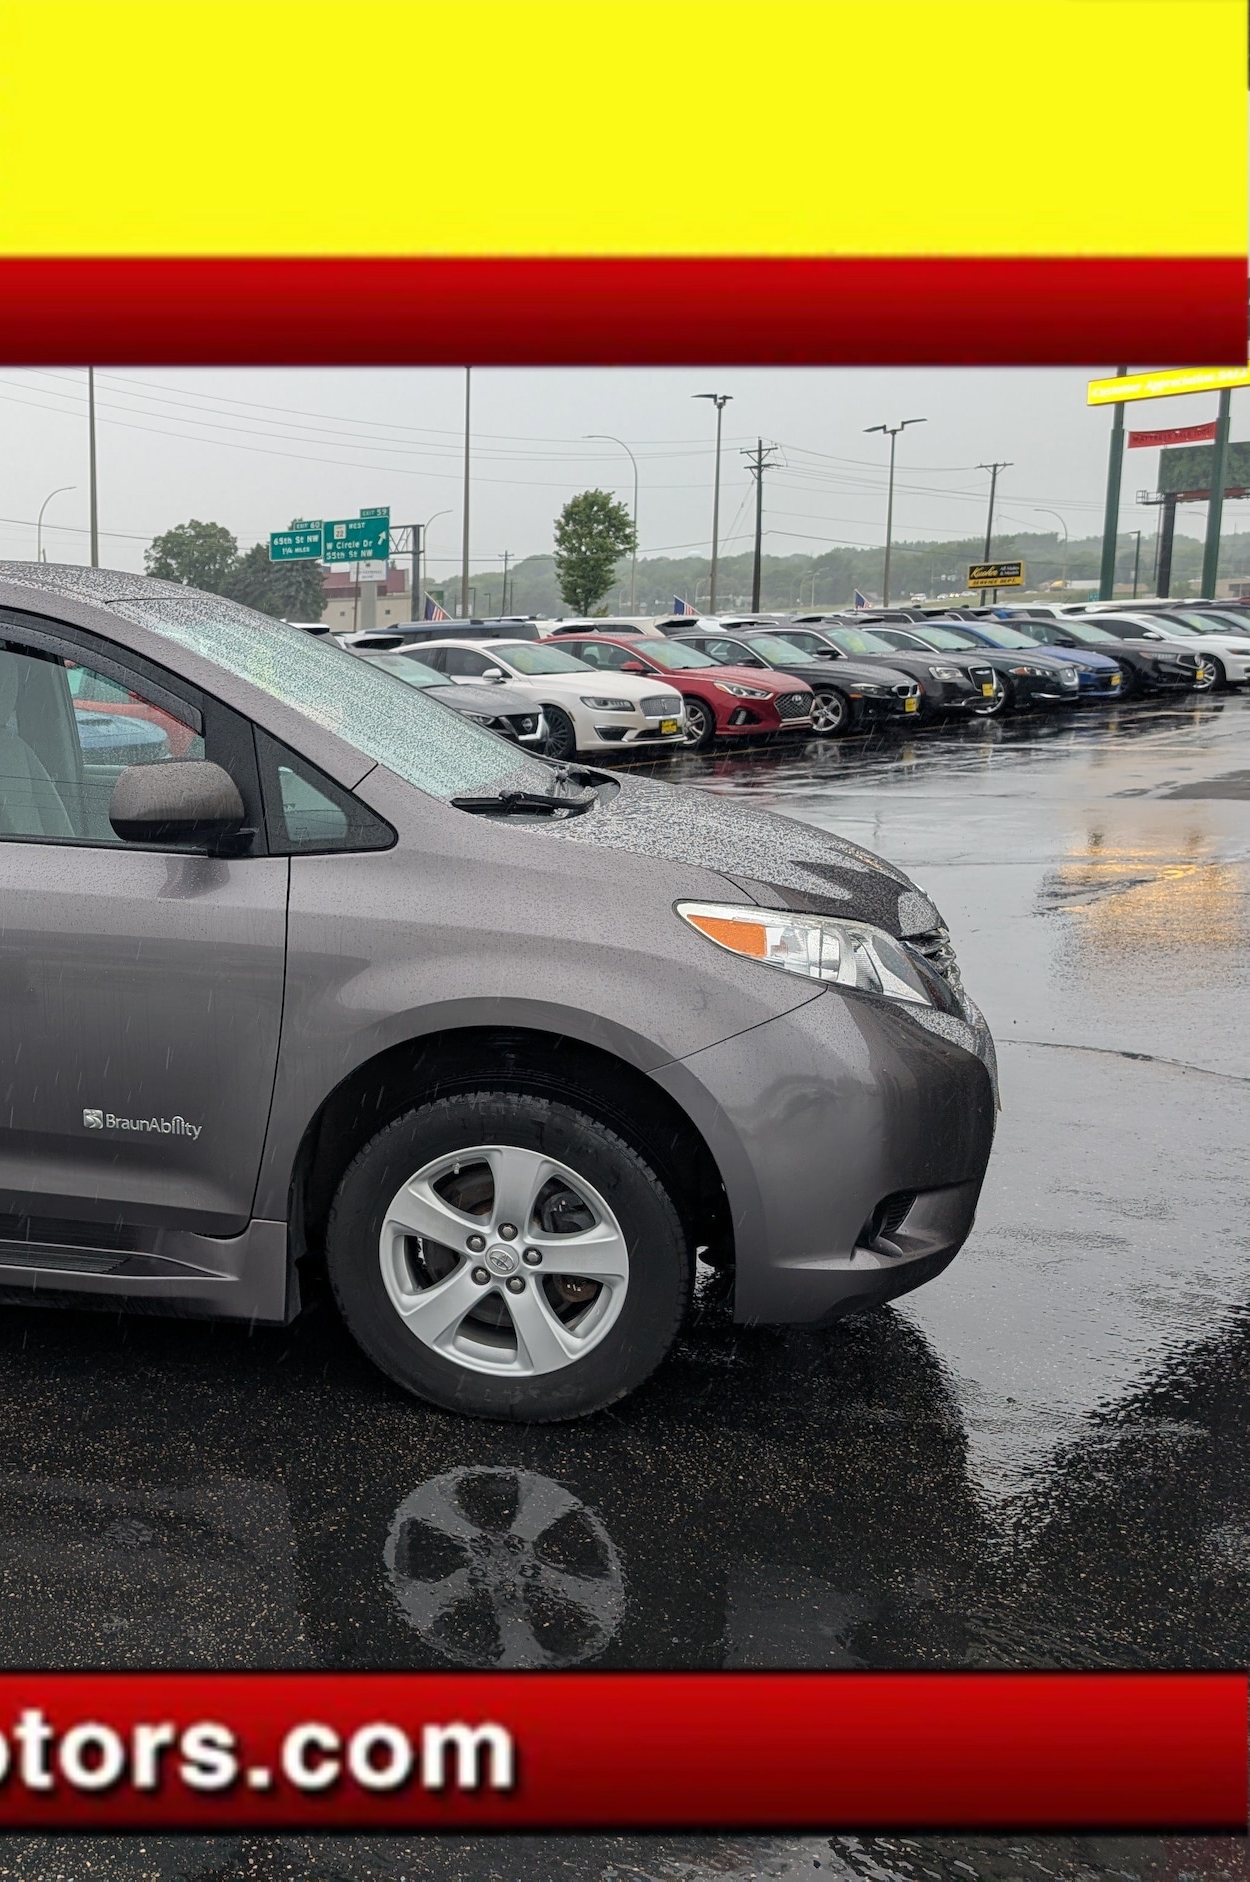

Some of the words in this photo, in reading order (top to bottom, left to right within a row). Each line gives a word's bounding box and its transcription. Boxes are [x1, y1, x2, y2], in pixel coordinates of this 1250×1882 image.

[376, 508, 387, 516] 59
[309, 521, 320, 529] 60
[348, 522, 366, 530] WEST
[273, 536, 293, 546] 65th
[295, 535, 304, 544] St
[306, 534, 319, 543] NW
[326, 542, 333, 550] W
[336, 540, 360, 549] Circle
[362, 539, 373, 548] Dr
[326, 551, 345, 560] 55th
[348, 550, 358, 558] St
[360, 549, 373, 558] NW
[105, 1113, 203, 1141] BraunAbility
